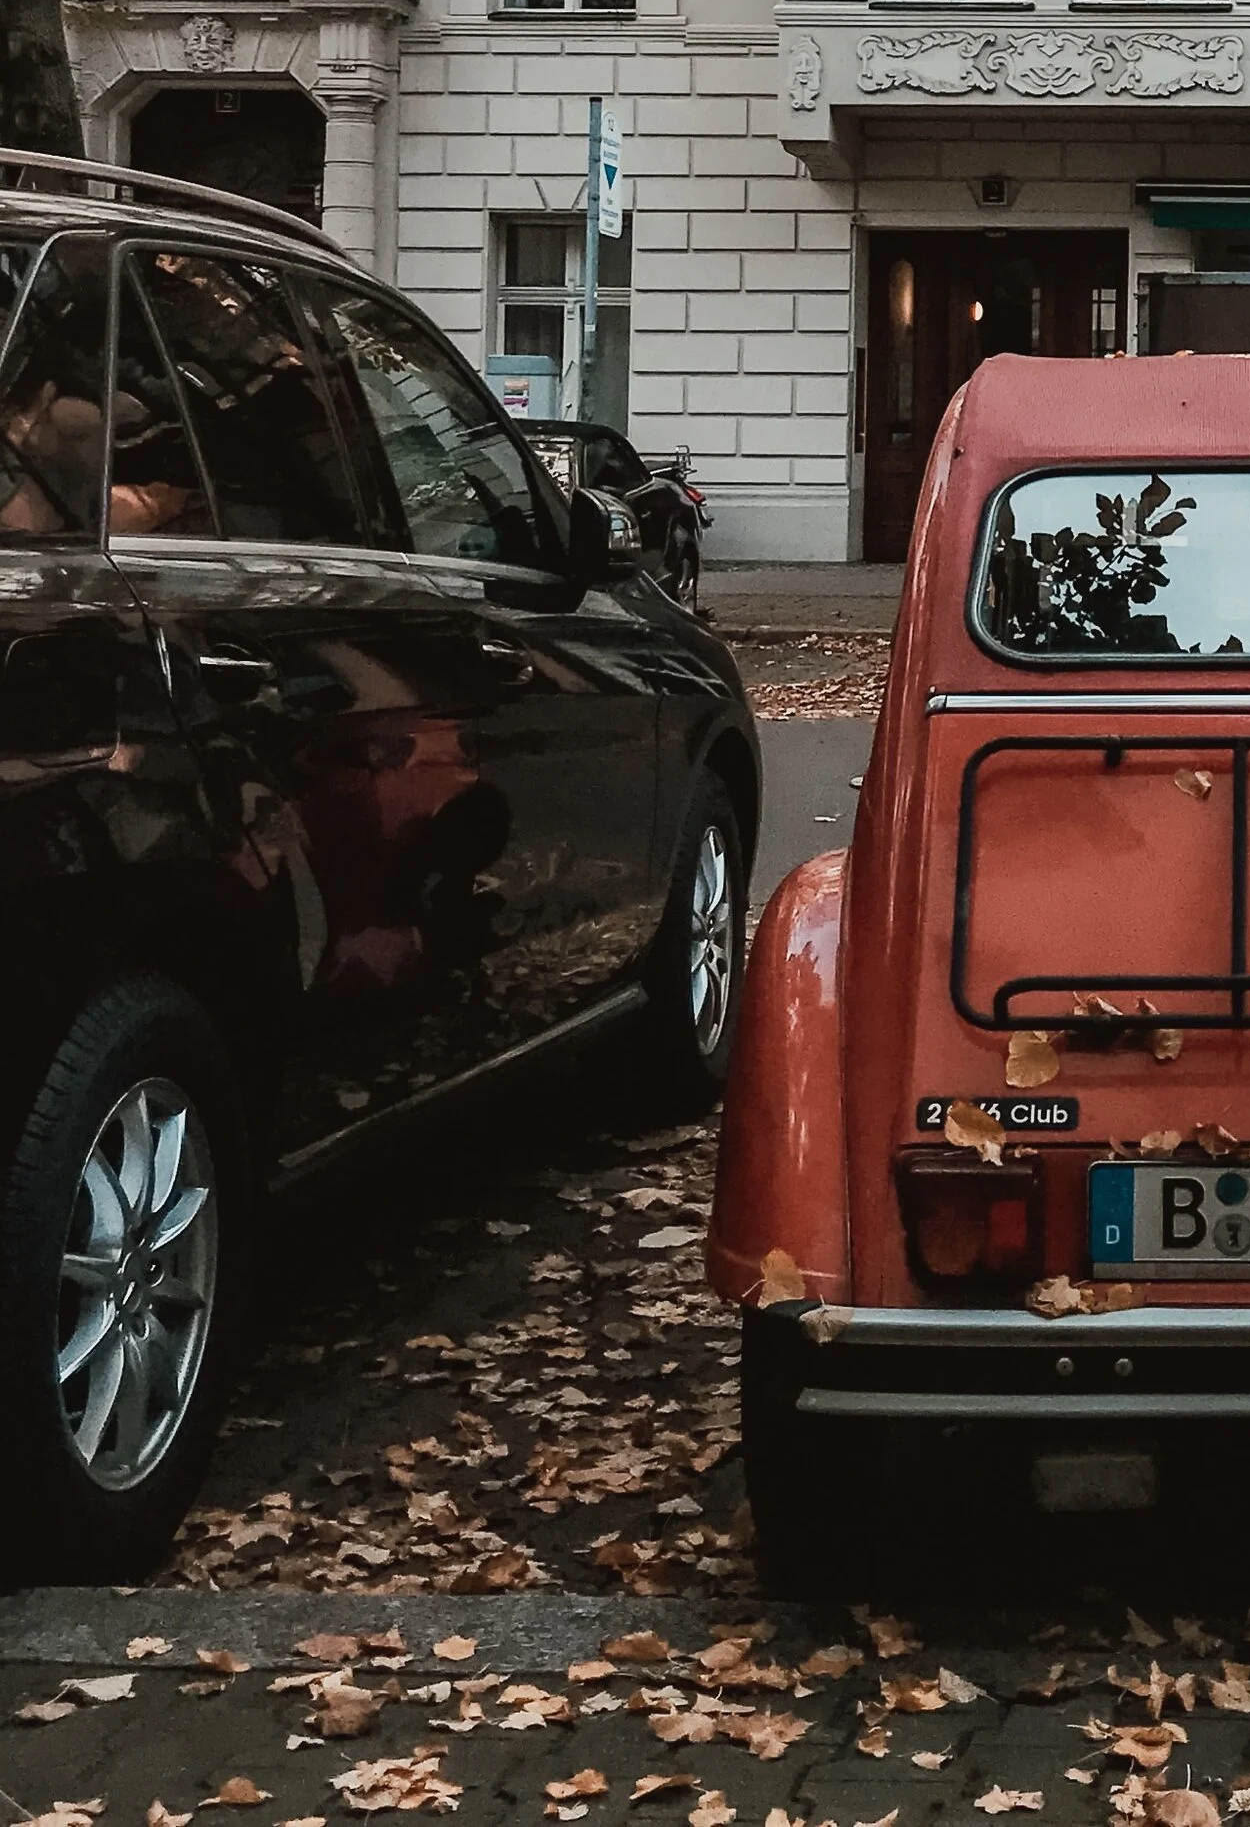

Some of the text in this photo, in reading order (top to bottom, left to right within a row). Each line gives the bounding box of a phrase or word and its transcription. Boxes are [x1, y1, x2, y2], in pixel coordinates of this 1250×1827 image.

[223, 92, 233, 109] 2
[1010, 1104, 1068, 1124] Club
[1161, 1176, 1208, 1250] B
[1105, 1224, 1121, 1245] D
